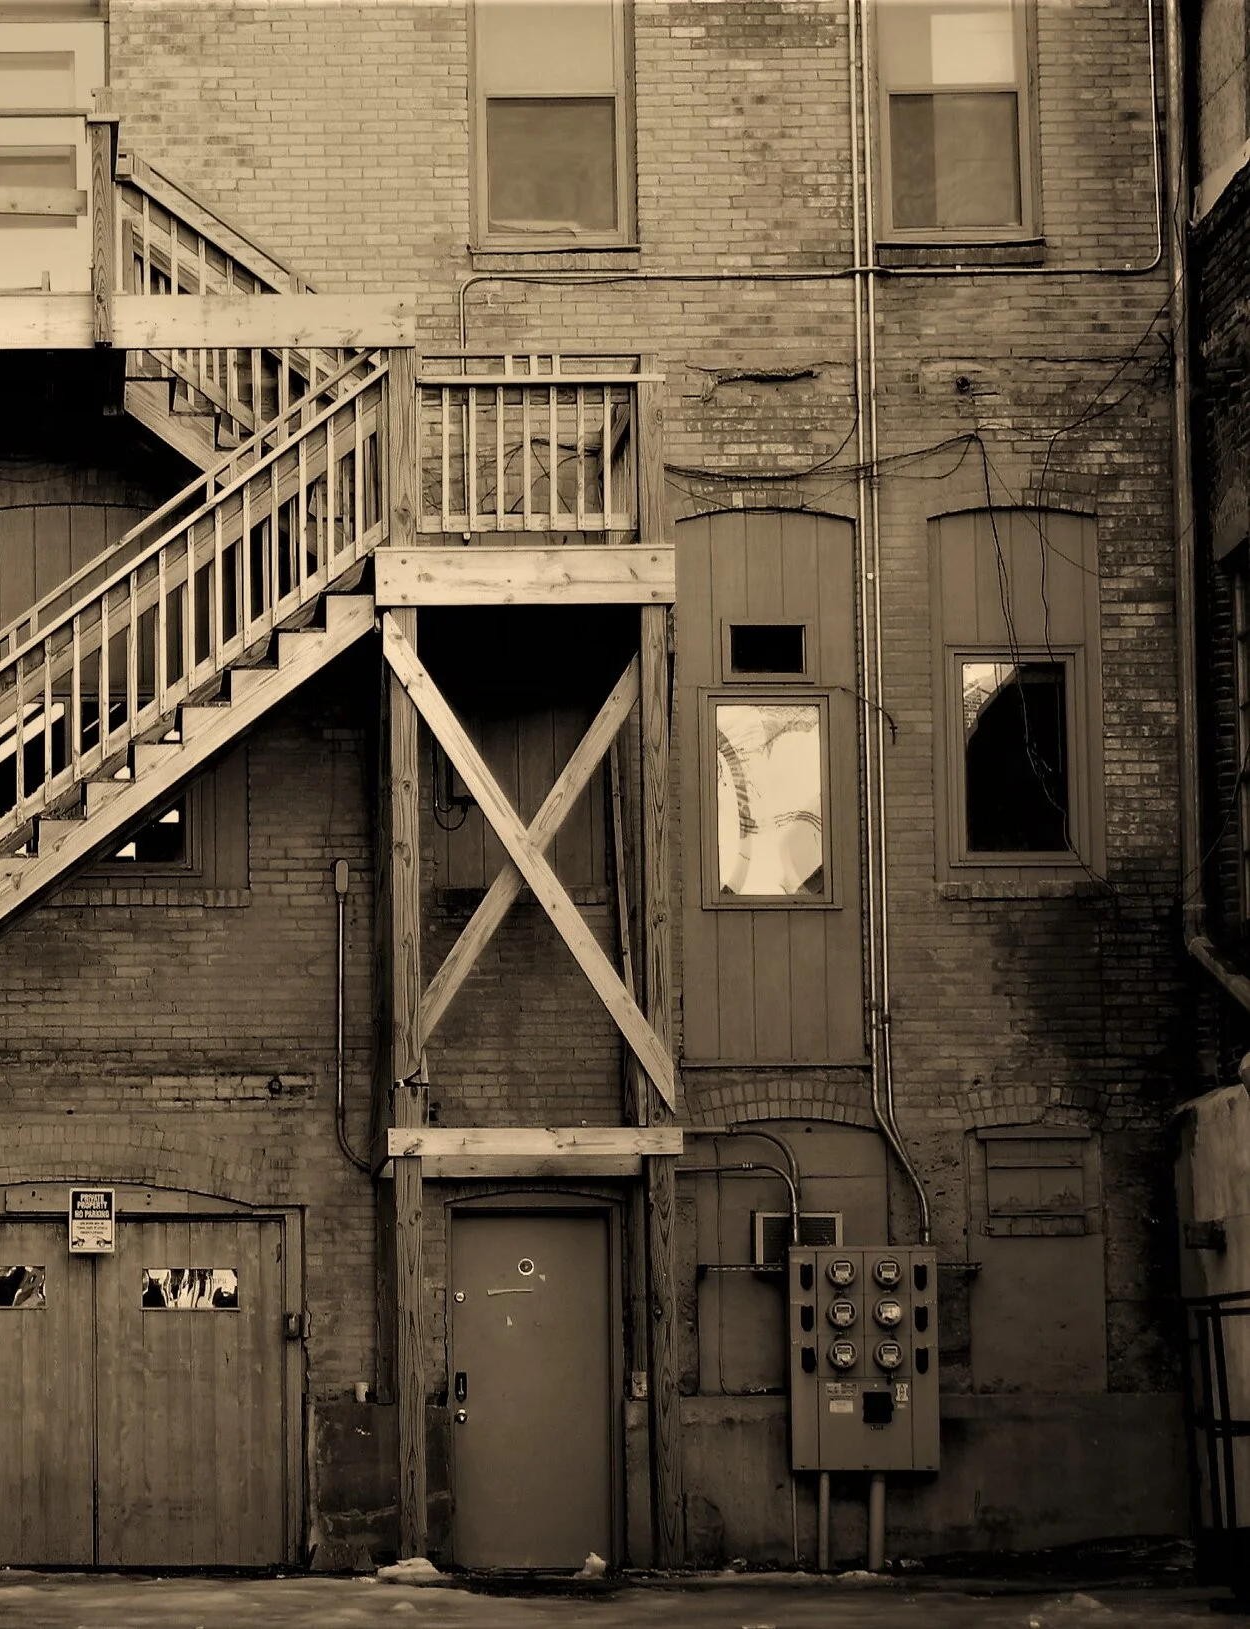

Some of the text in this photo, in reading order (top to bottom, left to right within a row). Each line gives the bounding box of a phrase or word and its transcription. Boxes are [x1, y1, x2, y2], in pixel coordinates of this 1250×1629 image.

[80, 1193, 104, 1202] PRIVATE
[77, 1201, 108, 1209] PROPERTY
[74, 1210, 110, 1218] NO PARKING
